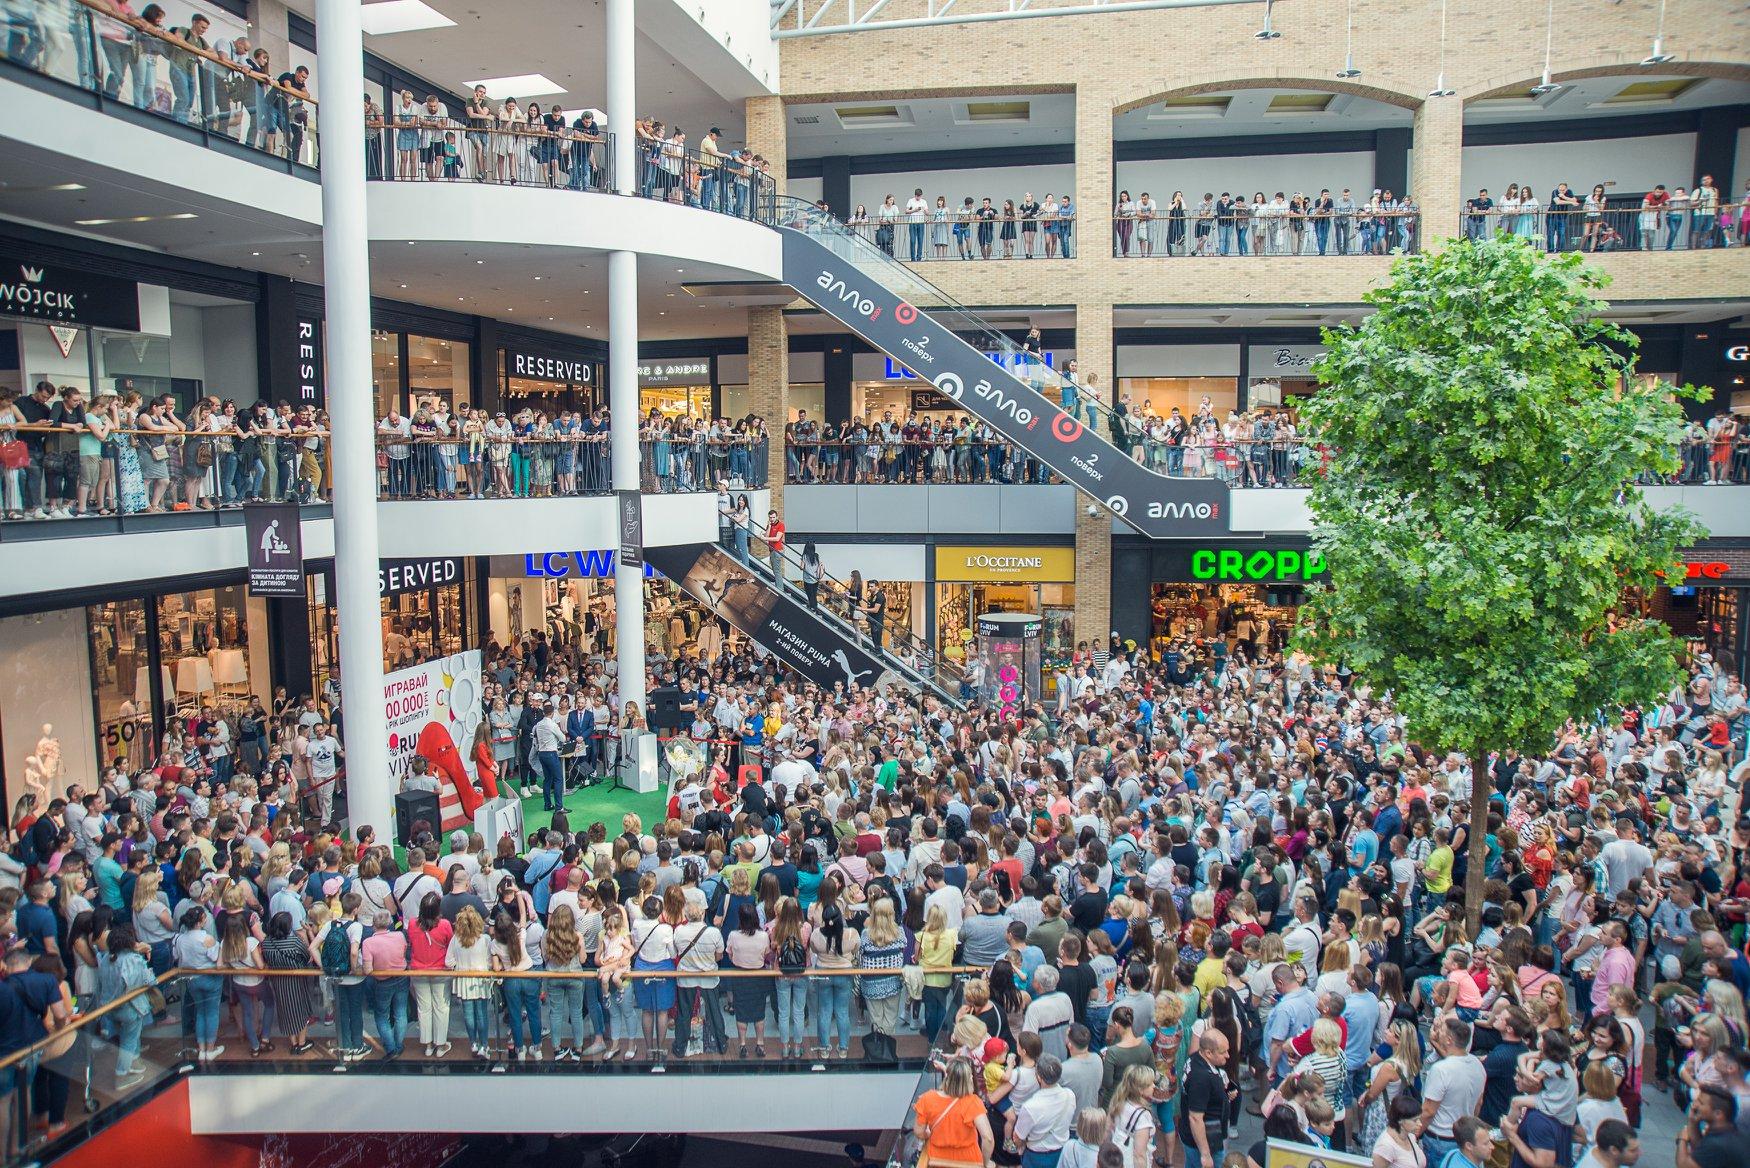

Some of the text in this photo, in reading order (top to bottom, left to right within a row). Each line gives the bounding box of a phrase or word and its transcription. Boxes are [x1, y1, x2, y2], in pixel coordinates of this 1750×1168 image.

[901, 338, 935, 364] поверх
[917, 336, 930, 349] 2
[1727, 345, 1750, 361] G
[299, 322, 315, 399] RESE
[516, 354, 591, 382] RESERVED
[1070, 455, 1104, 482] поверх
[1086, 453, 1099, 467] 2
[525, 551, 570, 578] LC
[1191, 549, 1328, 581] CROPP
[769, 620, 831, 668] МАГАЗИН PUMA
[775, 638, 814, 667] 2-ИЙ ПОВЕРХ
[384, 672, 428, 699] ИГРАВАЙ
[386, 700, 400, 720] 00
[402, 693, 423, 714] 000
[388, 753, 411, 777] VIV
